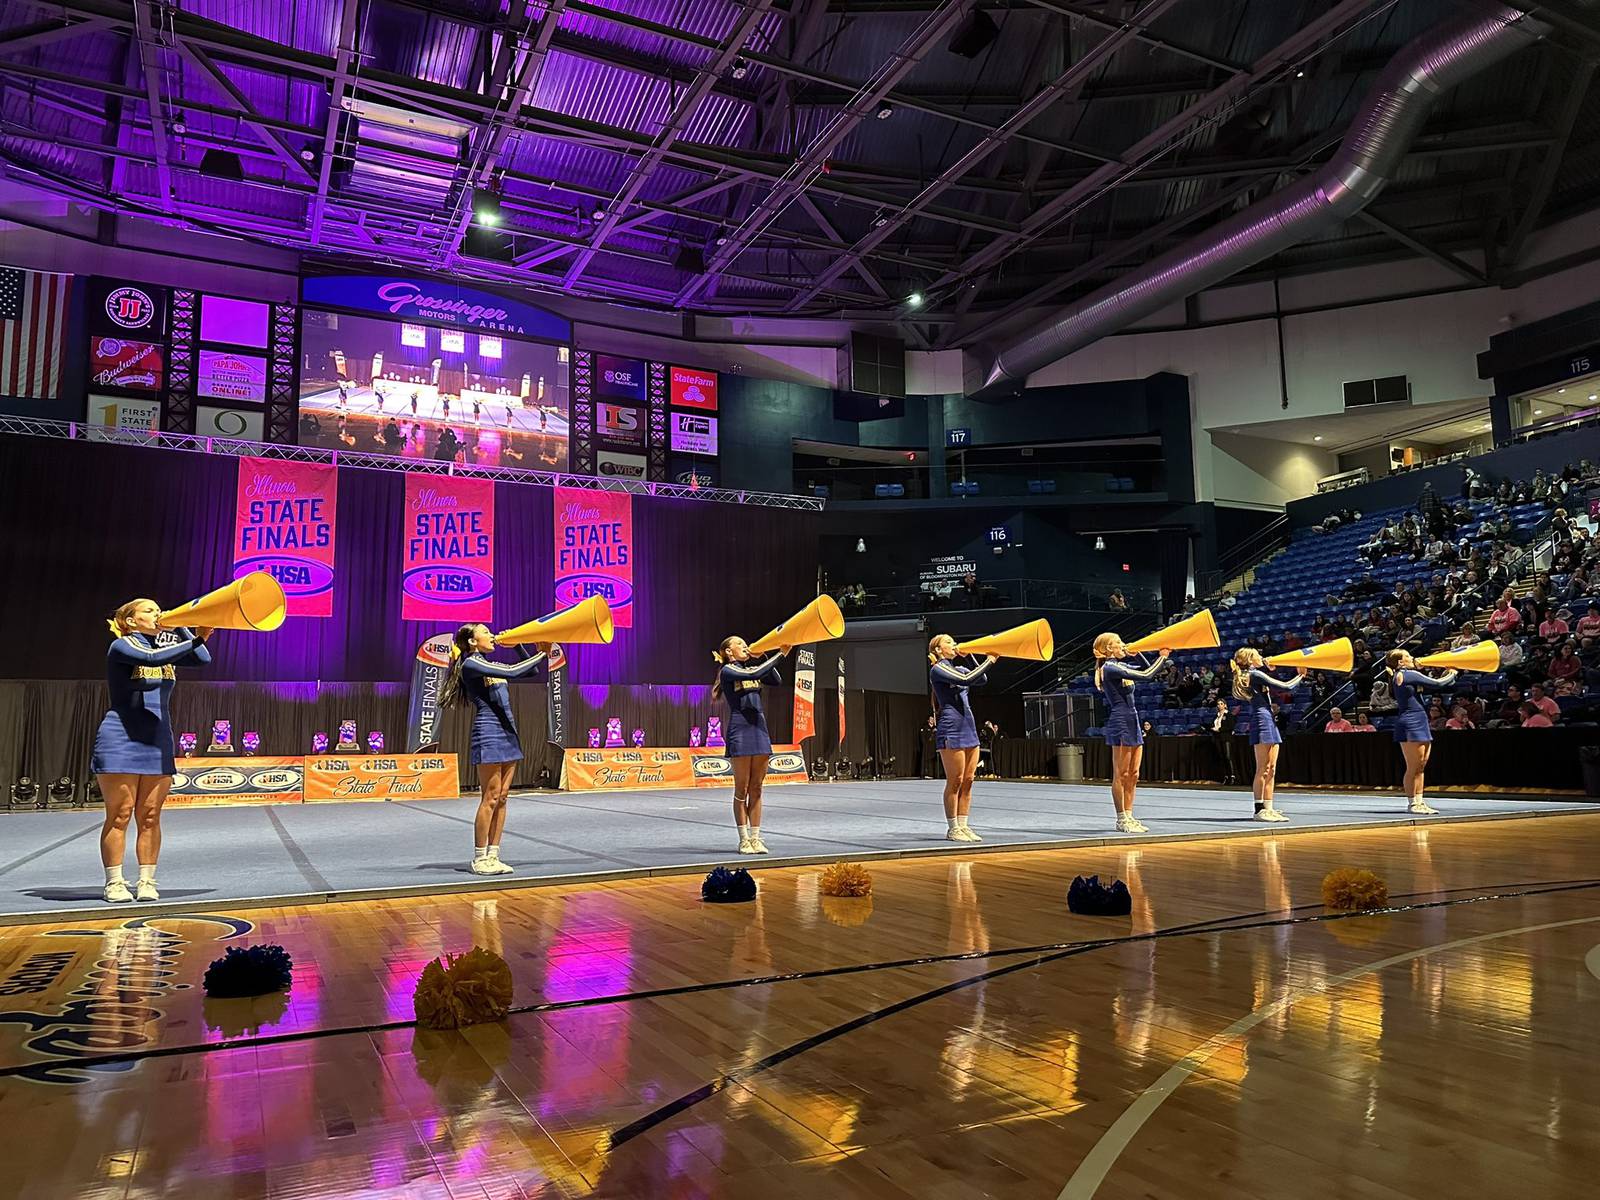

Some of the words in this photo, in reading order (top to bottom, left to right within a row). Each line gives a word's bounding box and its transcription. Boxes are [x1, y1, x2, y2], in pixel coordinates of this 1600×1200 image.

[118, 297, 142, 319] JJ
[378, 282, 508, 322] Grossinger
[418, 309, 455, 320] MOTORS
[479, 320, 524, 334] ARENA
[93, 344, 154, 386] Budweiser
[614, 371, 632, 381] OSF
[1571, 359, 1590, 373] 115
[121, 417, 152, 426] STATE
[122, 408, 152, 417] FIRST
[951, 433, 966, 443] 117
[245, 473, 296, 497] Illinois
[250, 498, 324, 523] STATE
[416, 511, 482, 535] STATE
[565, 523, 622, 546] STATE
[241, 523, 330, 551] FINALS
[990, 530, 1006, 540] 116
[409, 535, 489, 560] FINALS
[560, 545, 628, 570] FINALS
[936, 563, 977, 574] SUBARU
[423, 666, 438, 708] FINALS
[553, 671, 561, 701] STATE
[420, 711, 434, 744] STATE
[333, 776, 377, 797] State
[379, 772, 423, 793] Finals
[593, 767, 627, 786] State
[628, 765, 664, 783] Finals
